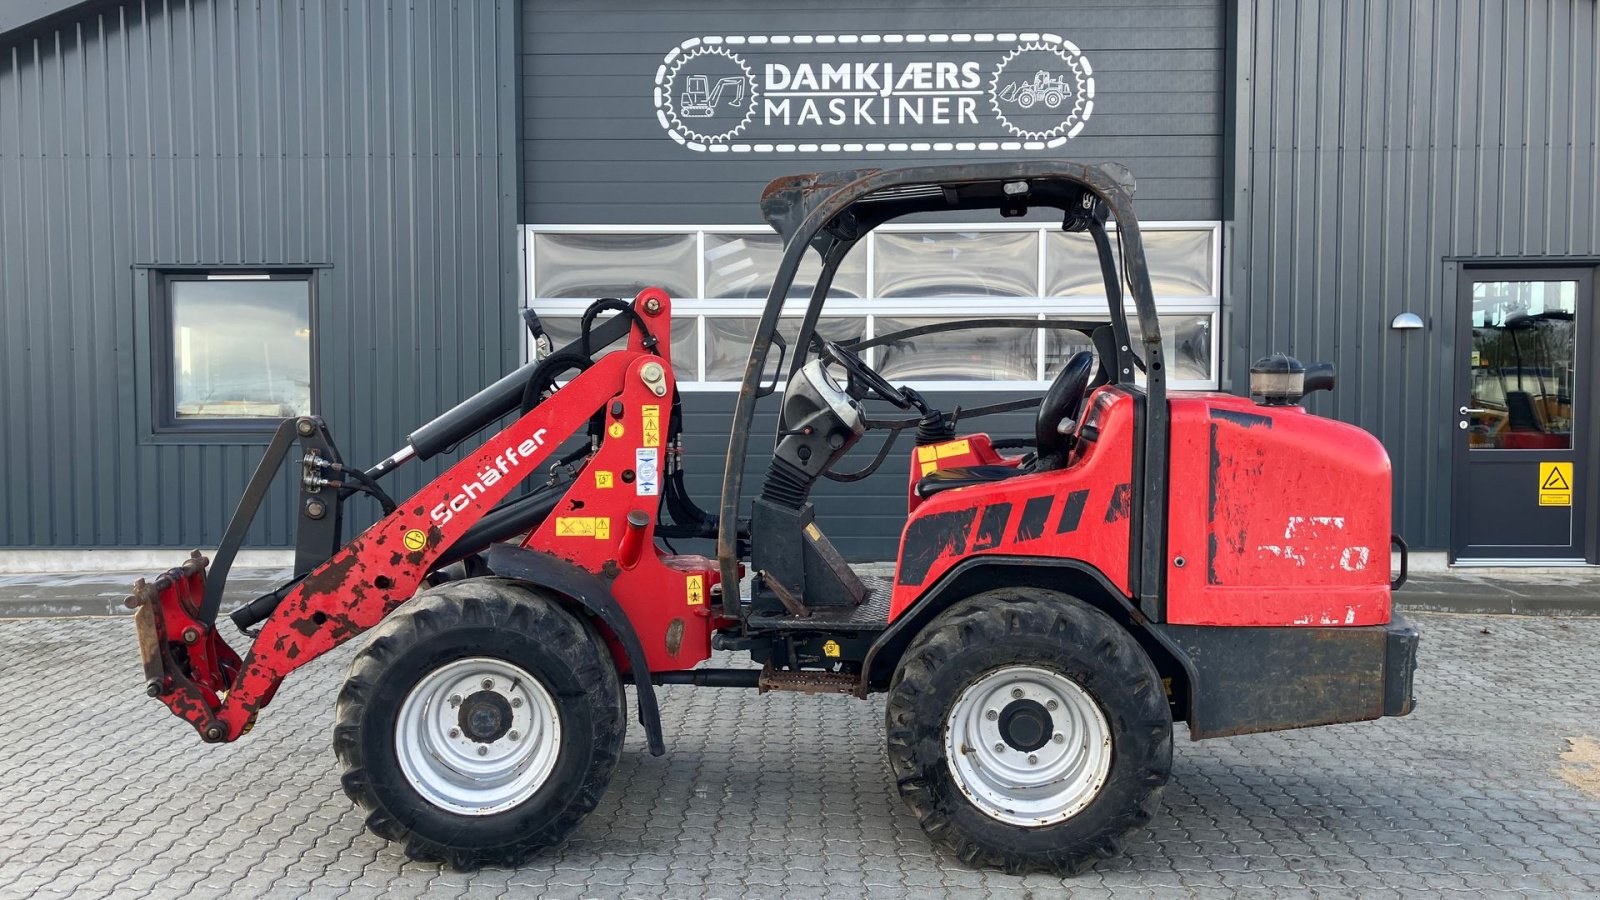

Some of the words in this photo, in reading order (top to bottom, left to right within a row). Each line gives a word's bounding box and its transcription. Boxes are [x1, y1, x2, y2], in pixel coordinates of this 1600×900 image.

[765, 62, 981, 97] DAMKJÆRS
[764, 98, 980, 126] MASKINER
[430, 428, 548, 527] Schäffer
